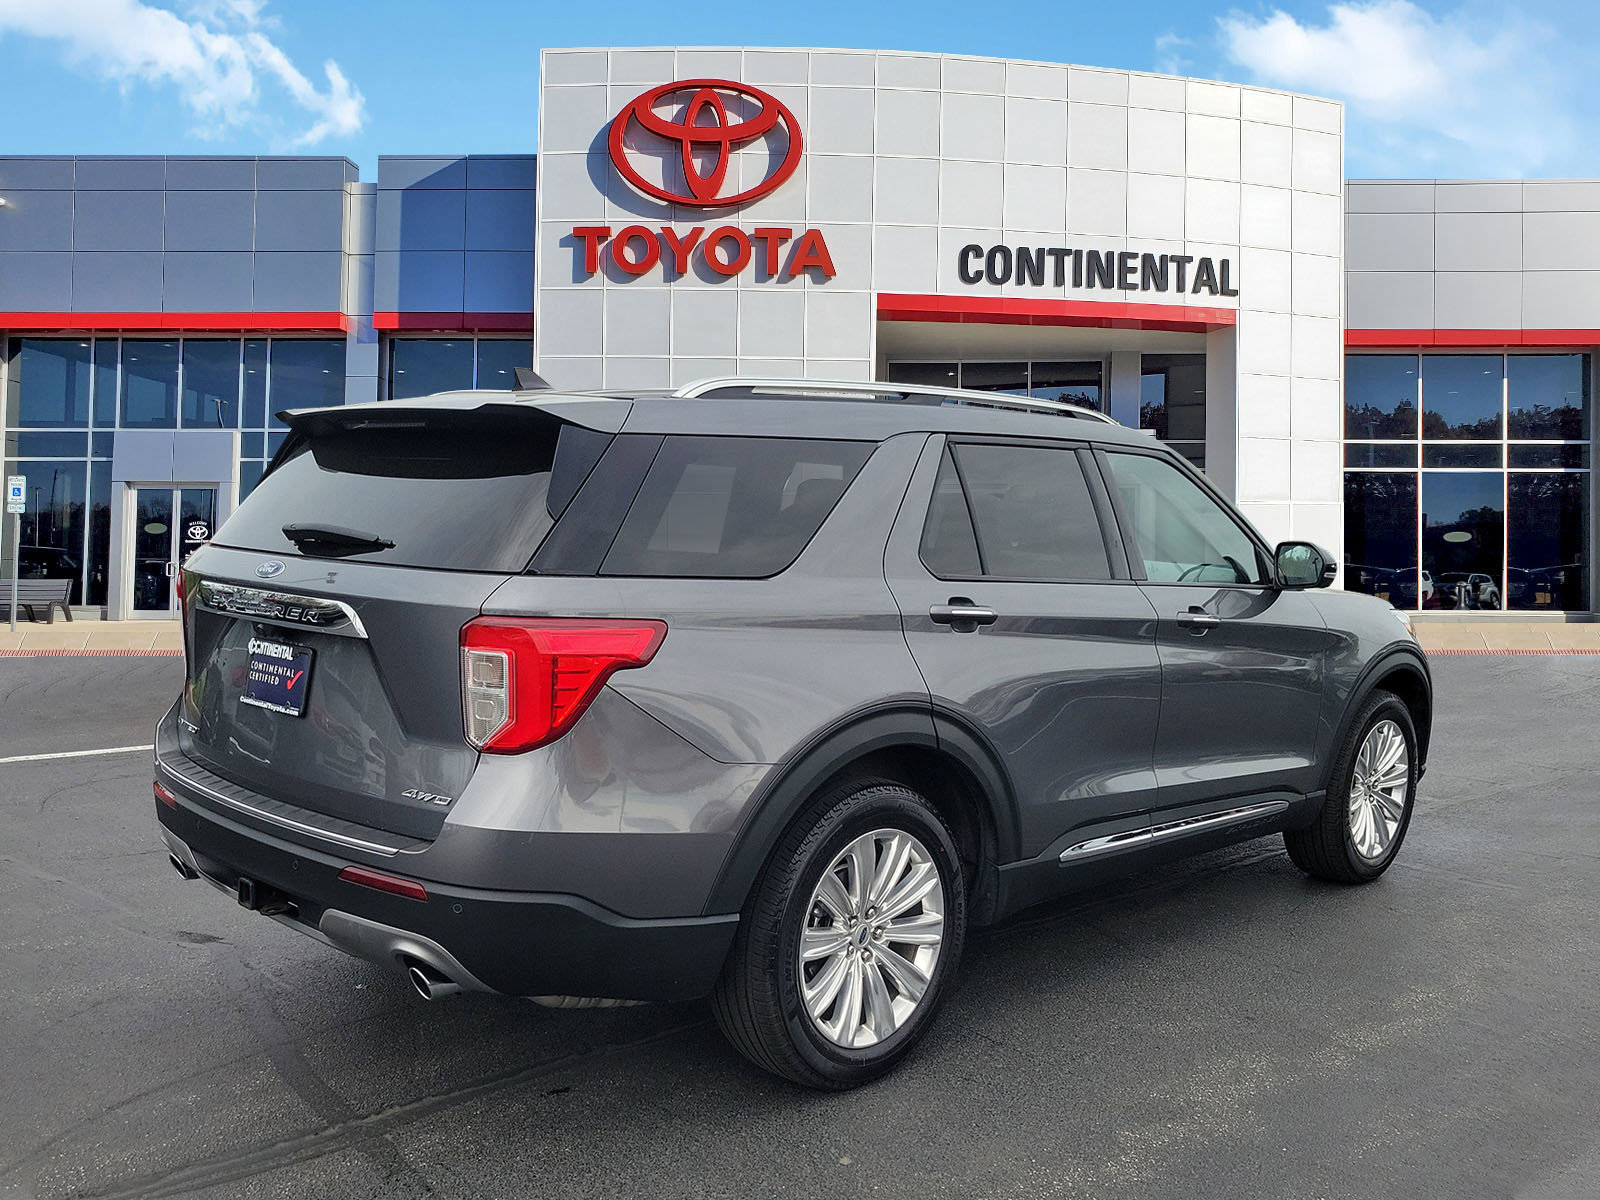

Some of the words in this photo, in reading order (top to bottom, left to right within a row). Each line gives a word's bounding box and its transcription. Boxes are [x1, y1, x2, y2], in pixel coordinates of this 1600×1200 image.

[573, 225, 837, 278] TOYOTA
[958, 243, 1239, 298] CONTINENTAL
[249, 670, 280, 685] CERTIFIED
[250, 660, 295, 678] CONTINENTAL
[401, 788, 453, 806] 4WD
